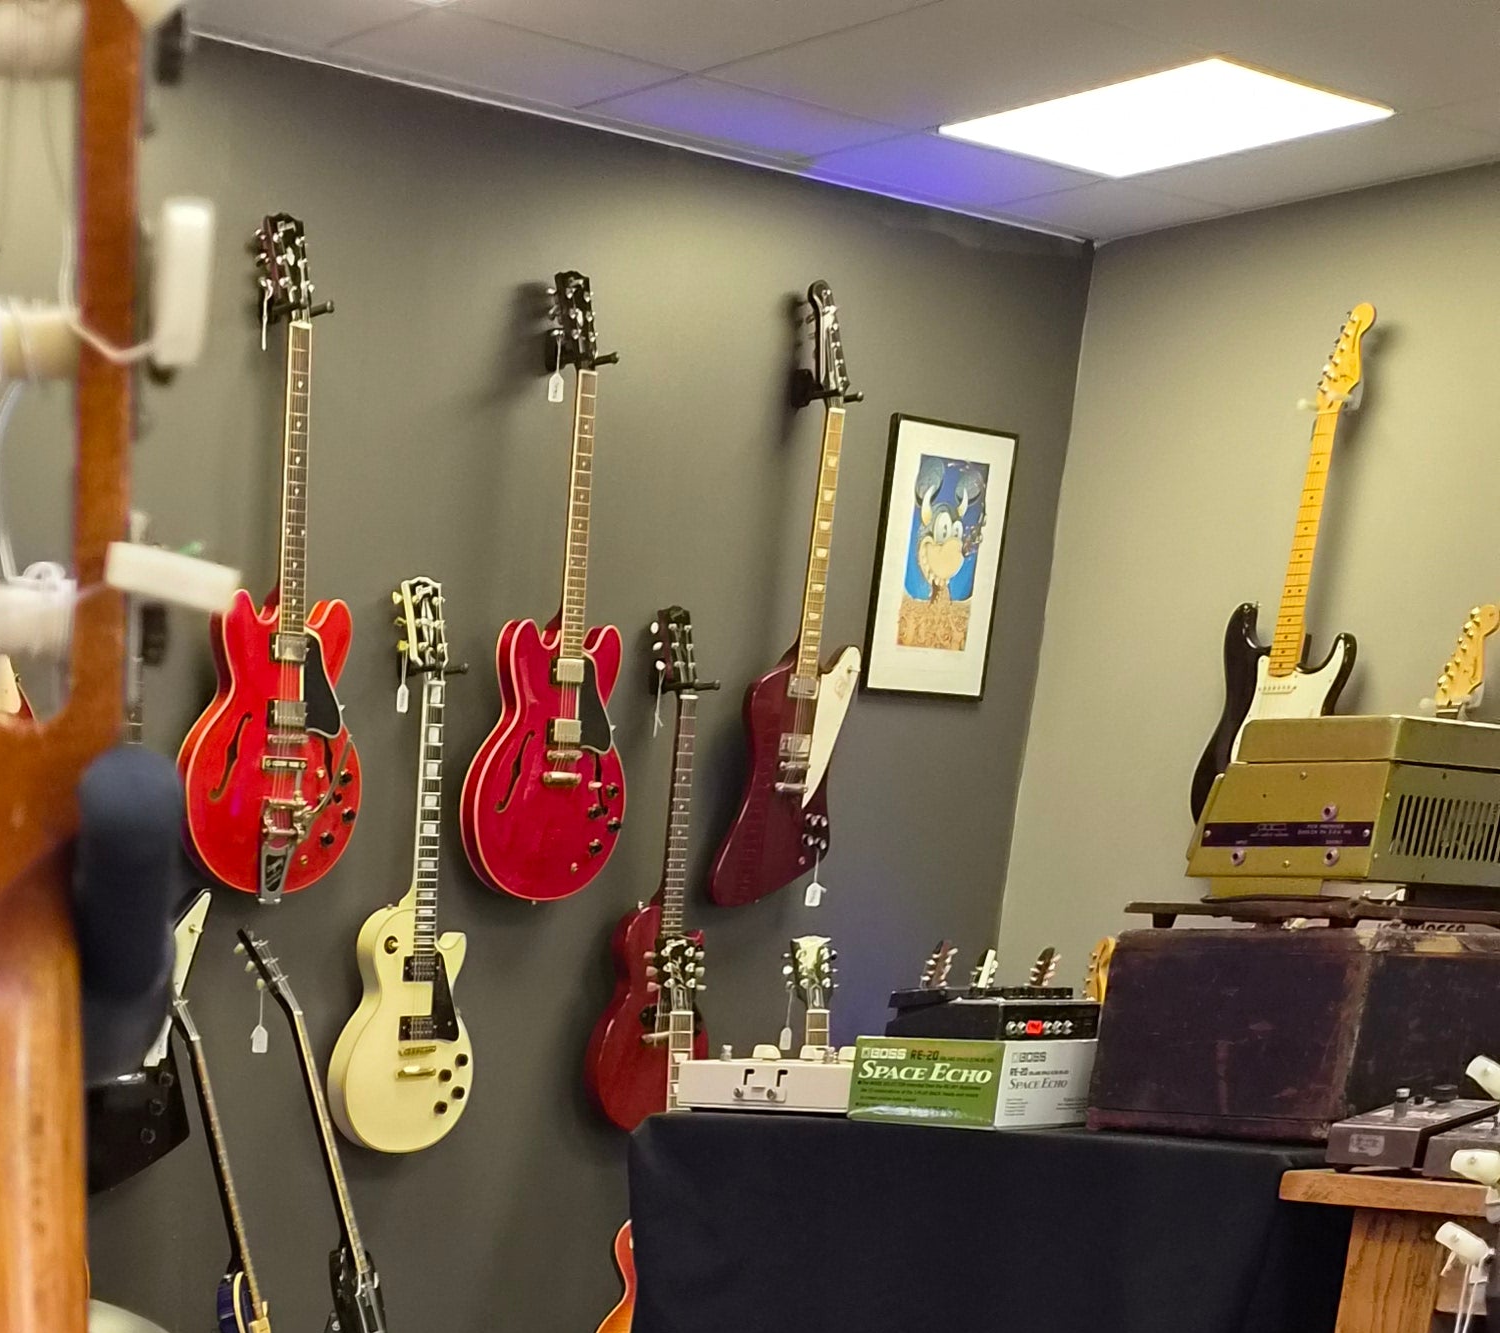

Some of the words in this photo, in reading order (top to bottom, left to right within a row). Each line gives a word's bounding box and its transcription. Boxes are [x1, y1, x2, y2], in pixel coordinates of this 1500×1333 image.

[869, 1047, 907, 1060] BOSS
[910, 1049, 940, 1061] RE-20
[858, 1060, 928, 1082] SPACE
[928, 1062, 992, 1084] ECHO
[1007, 1078, 1040, 1090] SPACE
[1040, 1078, 1069, 1090] ECHO
